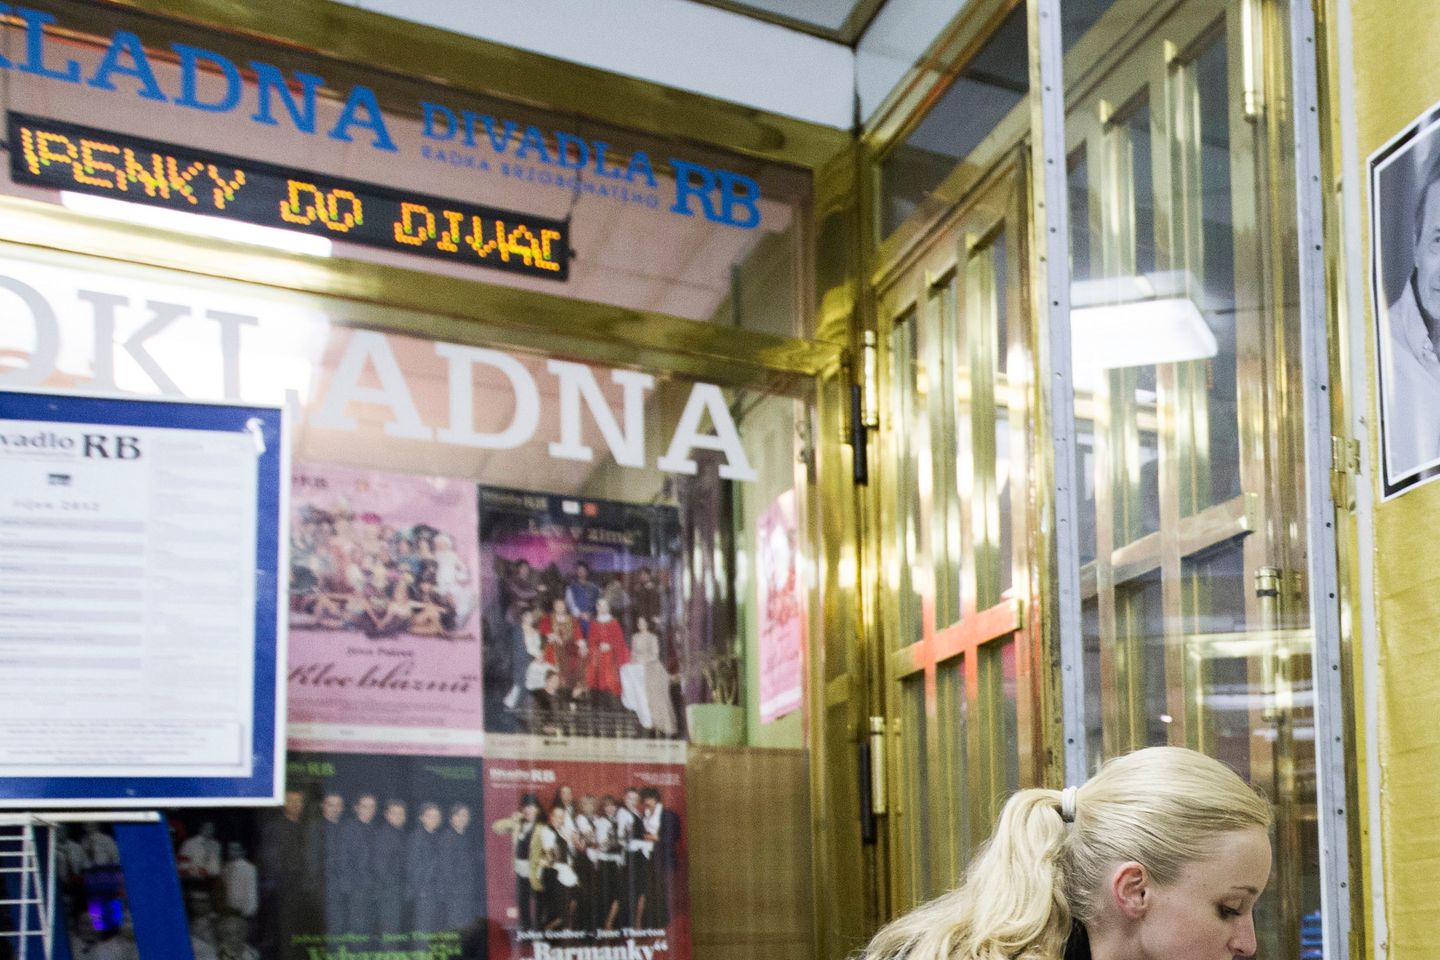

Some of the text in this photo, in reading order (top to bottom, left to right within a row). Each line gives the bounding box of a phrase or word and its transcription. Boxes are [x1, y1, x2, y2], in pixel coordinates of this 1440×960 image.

[420, 101, 658, 188] DIVADLA
[669, 157, 762, 229] RB
[279, 180, 364, 232] DO
[82, 433, 142, 460] RB
